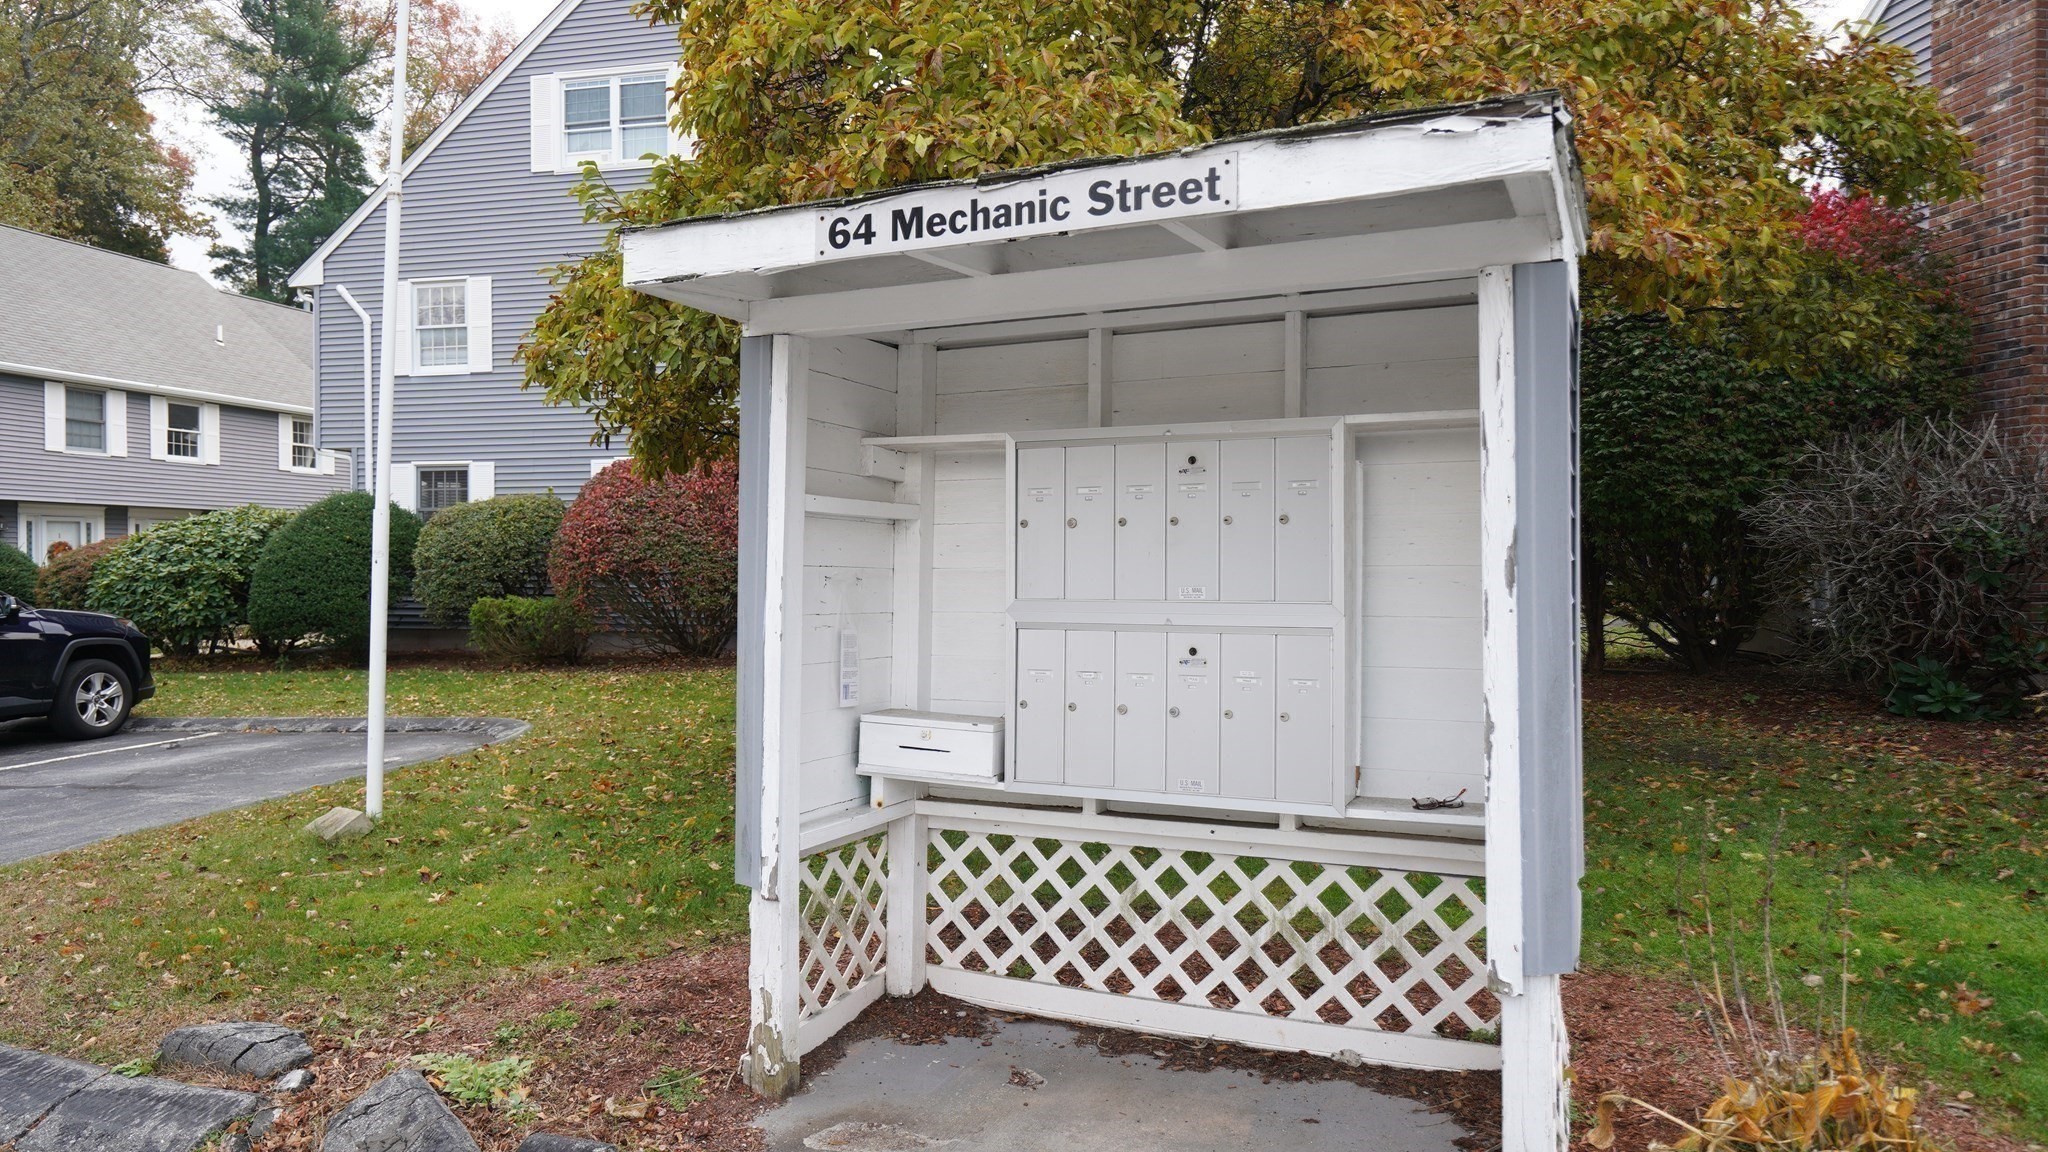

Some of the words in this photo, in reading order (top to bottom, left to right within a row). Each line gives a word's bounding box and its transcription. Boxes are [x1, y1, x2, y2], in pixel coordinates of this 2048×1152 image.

[828, 213, 877, 250] 64
[891, 188, 1071, 242] Mechanic
[1087, 167, 1221, 216] Street
